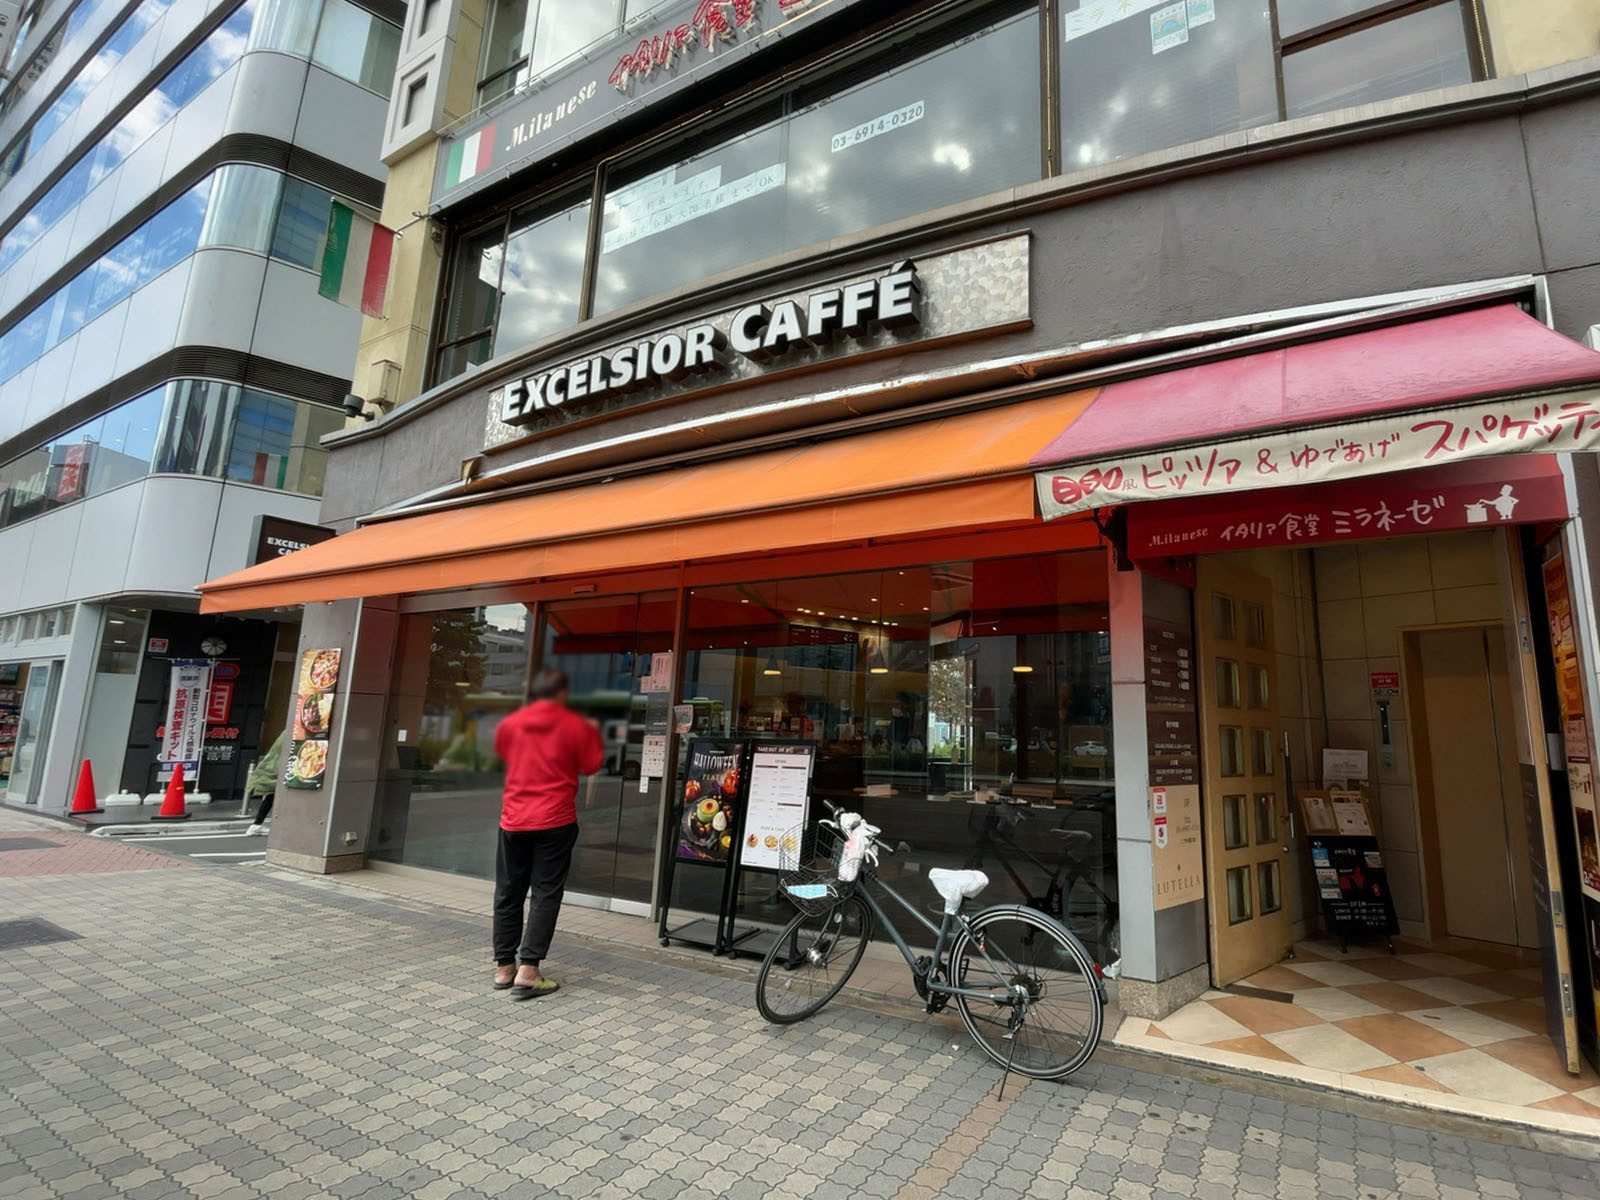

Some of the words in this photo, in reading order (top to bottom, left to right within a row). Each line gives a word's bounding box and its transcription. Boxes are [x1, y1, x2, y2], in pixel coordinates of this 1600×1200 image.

[832, 105, 923, 150] 03-6914-0320
[500, 322, 716, 424] EXCELSIOR
[728, 258, 920, 354] CAFFÉ
[1256, 447, 1280, 475] &
[1331, 495, 1447, 535] ミラネーゼ
[693, 752, 741, 771] HALLOWEEN
[1157, 876, 1200, 896] LUTELLA
